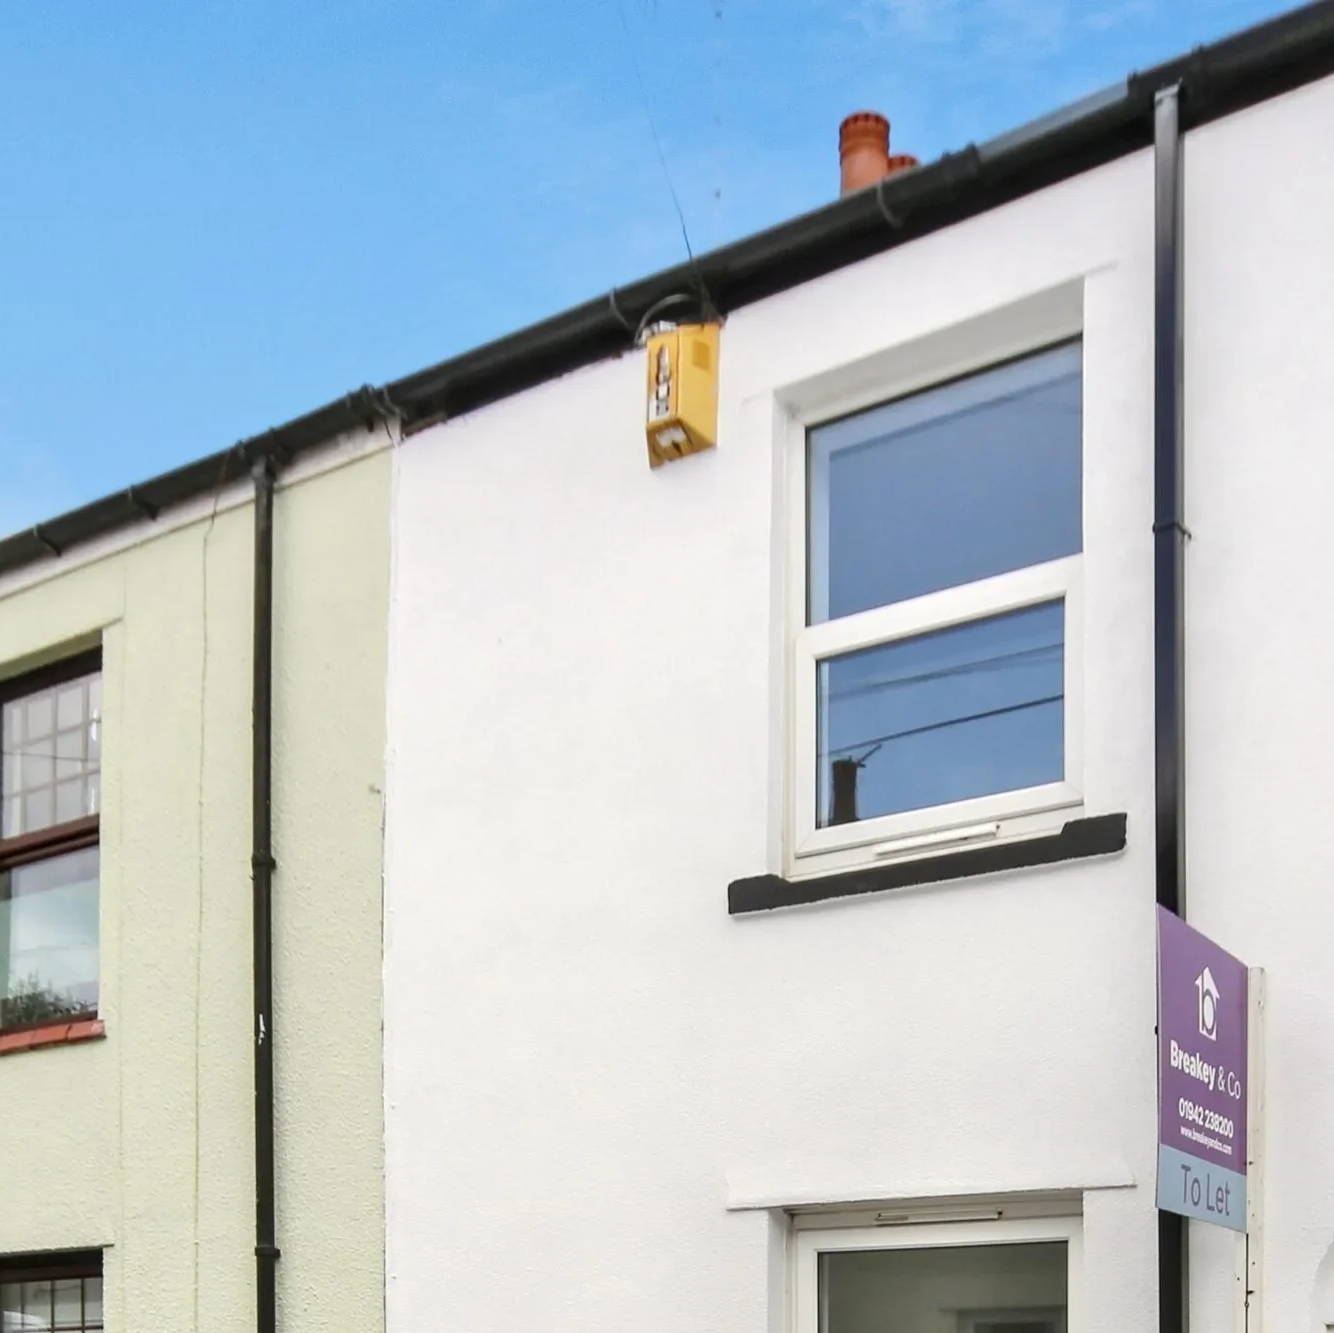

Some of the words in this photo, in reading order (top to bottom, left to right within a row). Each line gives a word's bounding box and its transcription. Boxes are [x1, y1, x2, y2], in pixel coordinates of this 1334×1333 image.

[1170, 1039, 1216, 1091] Breakey
[1217, 1065, 1225, 1092] &
[1227, 1071, 1241, 1100] Co
[1178, 1097, 1204, 1126] 01942
[1204, 1108, 1234, 1139] 238200
[1180, 1163, 1201, 1207] To
[1206, 1172, 1230, 1217] Let
